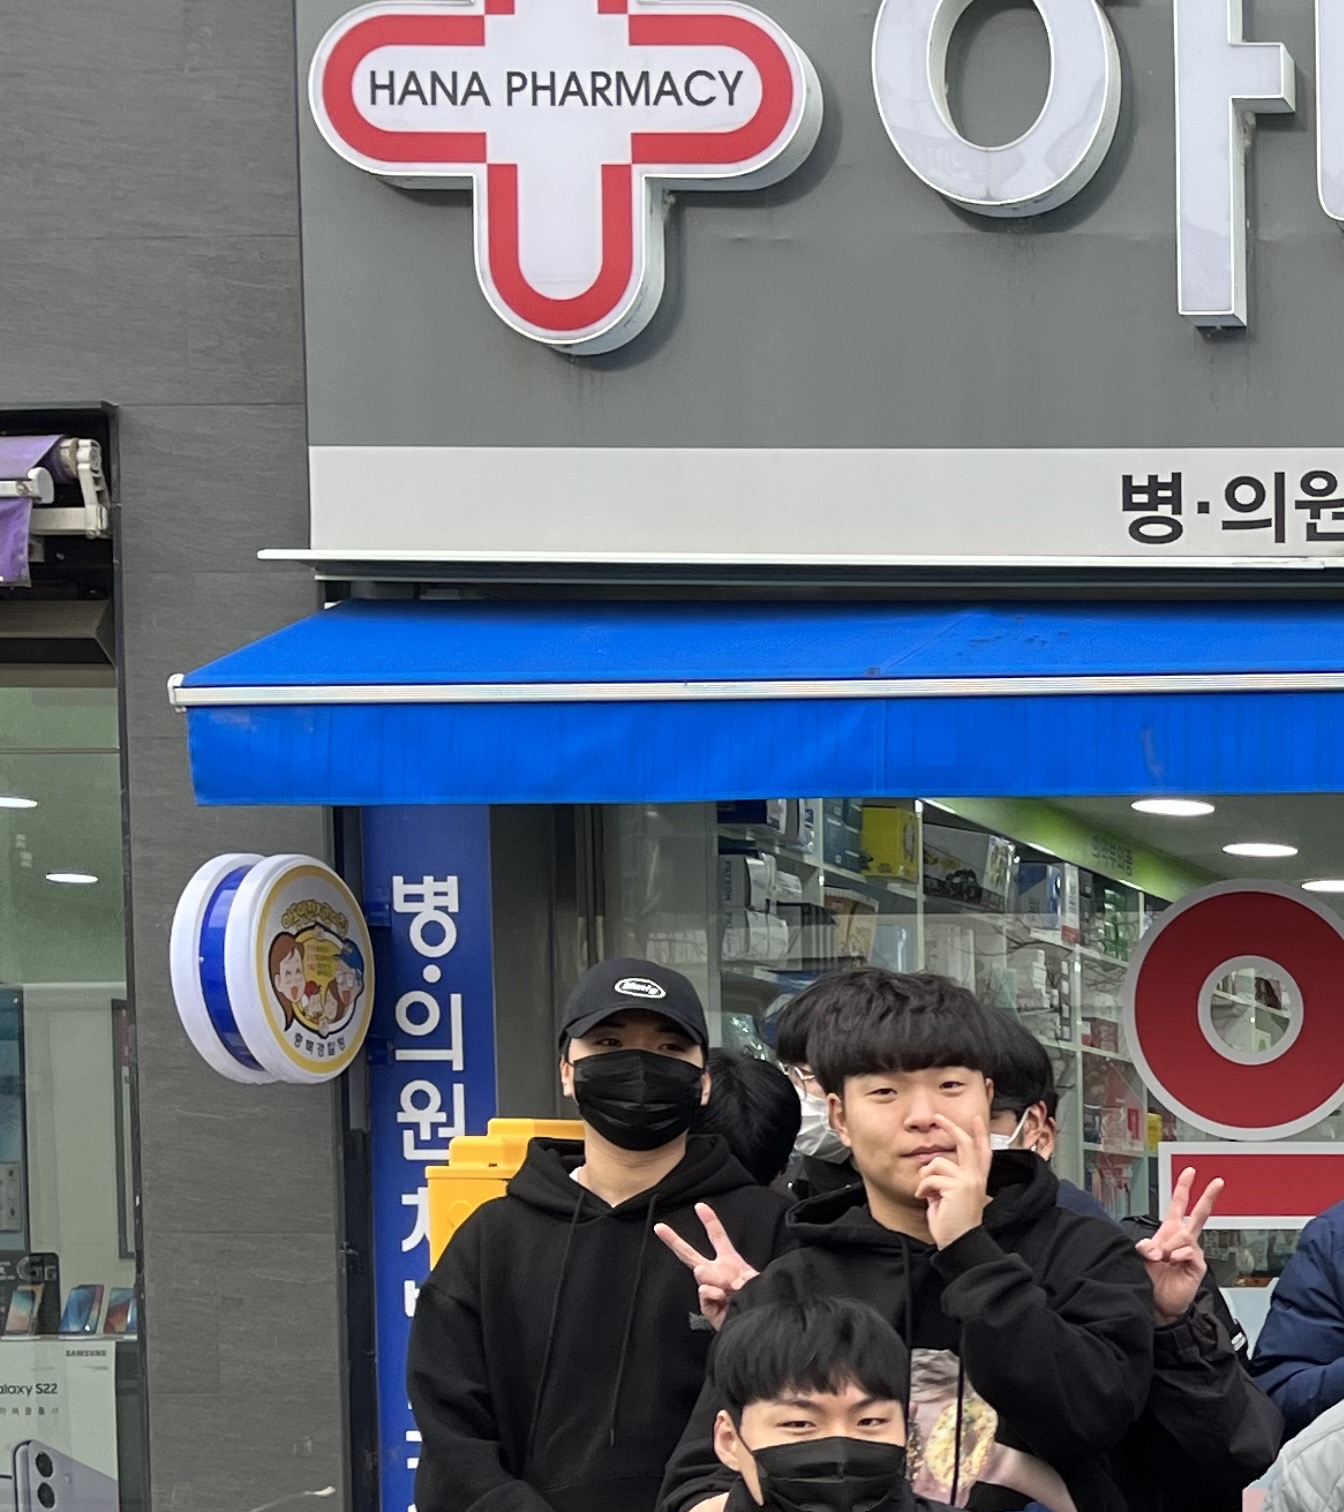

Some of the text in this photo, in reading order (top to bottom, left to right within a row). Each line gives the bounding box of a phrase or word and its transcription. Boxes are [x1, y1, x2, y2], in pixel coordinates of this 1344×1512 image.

[368, 69, 744, 108] HANA PHARMACY
[0, 1382, 58, 1397] alaxy S22
